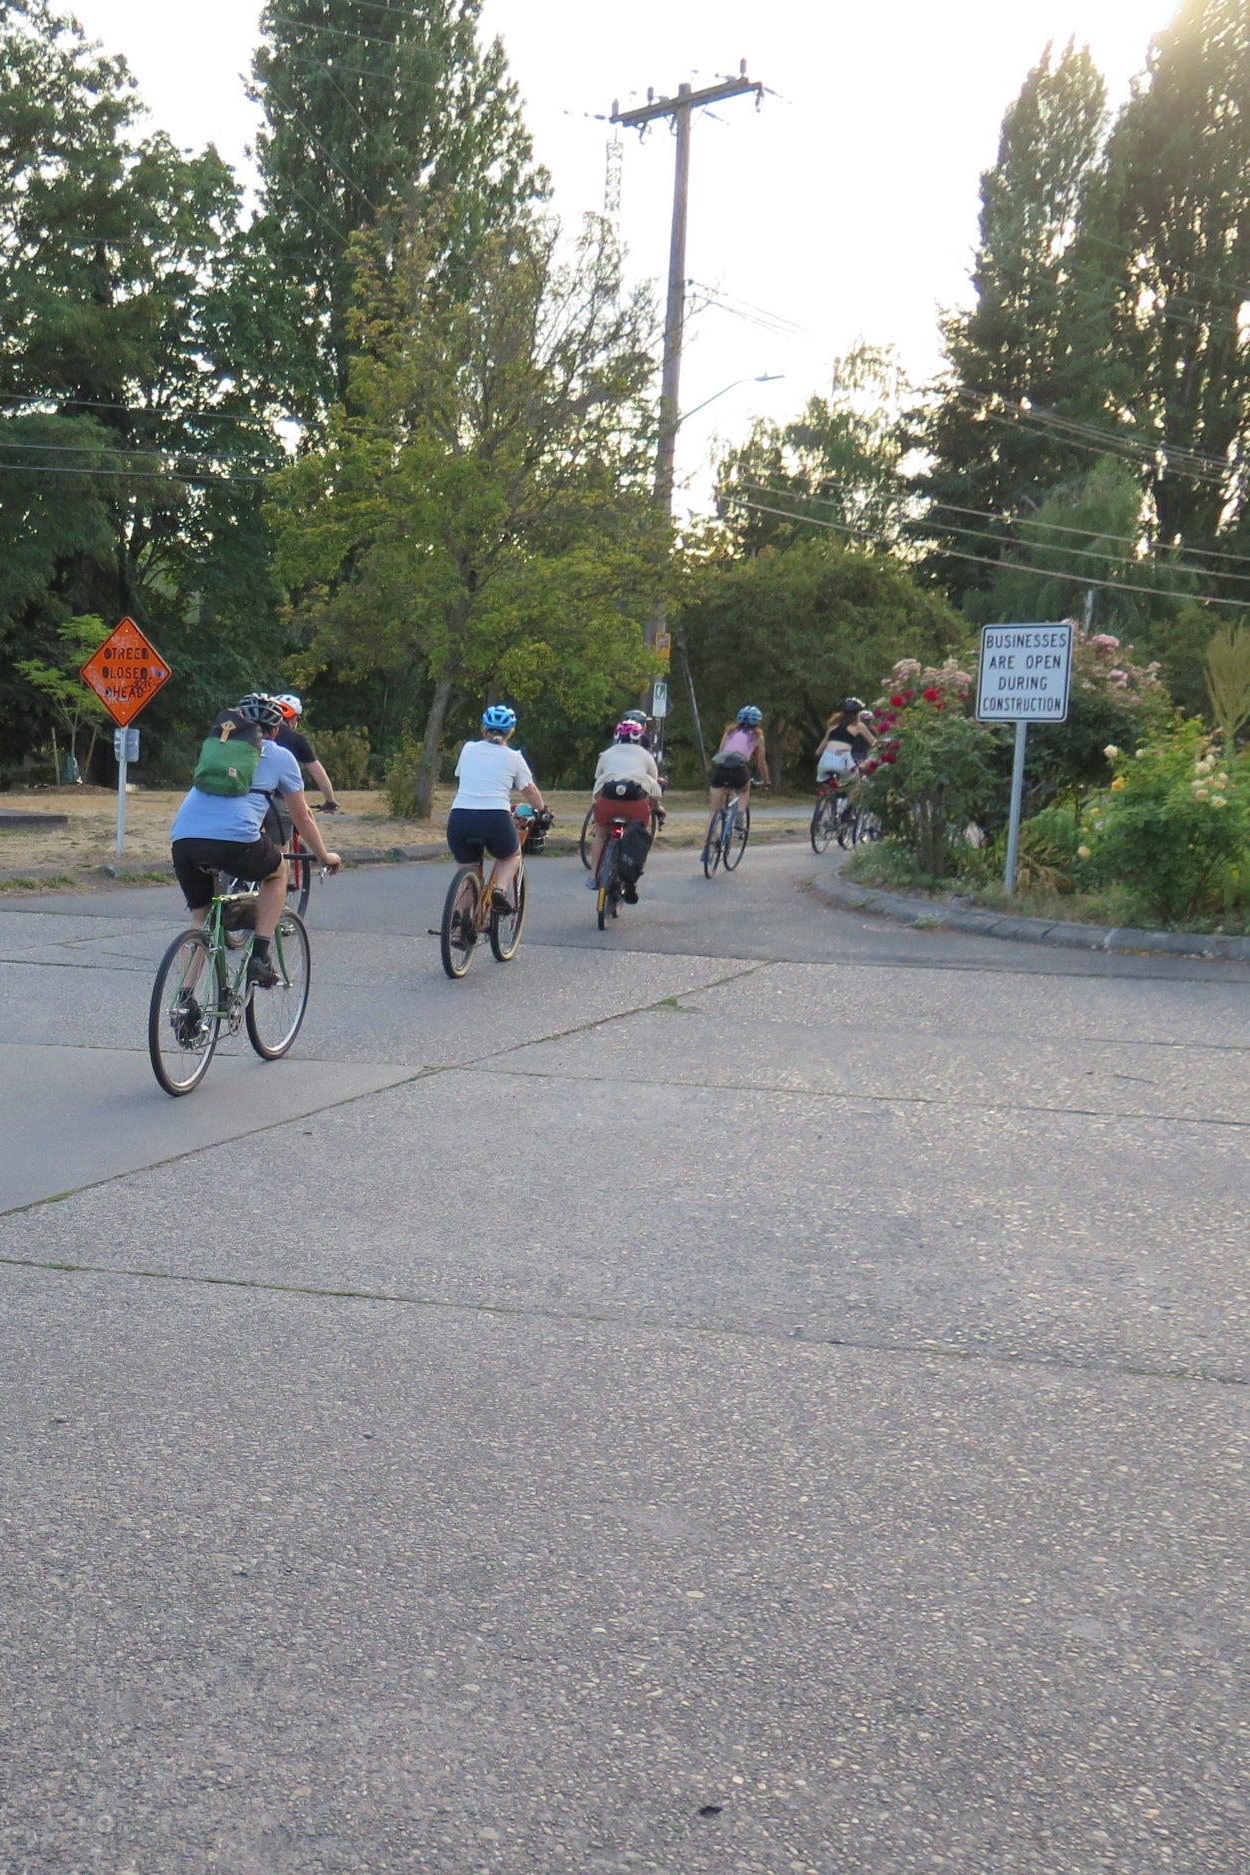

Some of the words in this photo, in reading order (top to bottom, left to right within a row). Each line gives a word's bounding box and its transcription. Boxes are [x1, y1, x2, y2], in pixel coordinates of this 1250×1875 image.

[986, 633, 1067, 649] BUSINESSES
[989, 655, 1015, 669] ARE
[1026, 654, 1061, 669] OPEN
[998, 676, 1048, 691] DURING
[983, 697, 1061, 711] CONSTRUCTION
